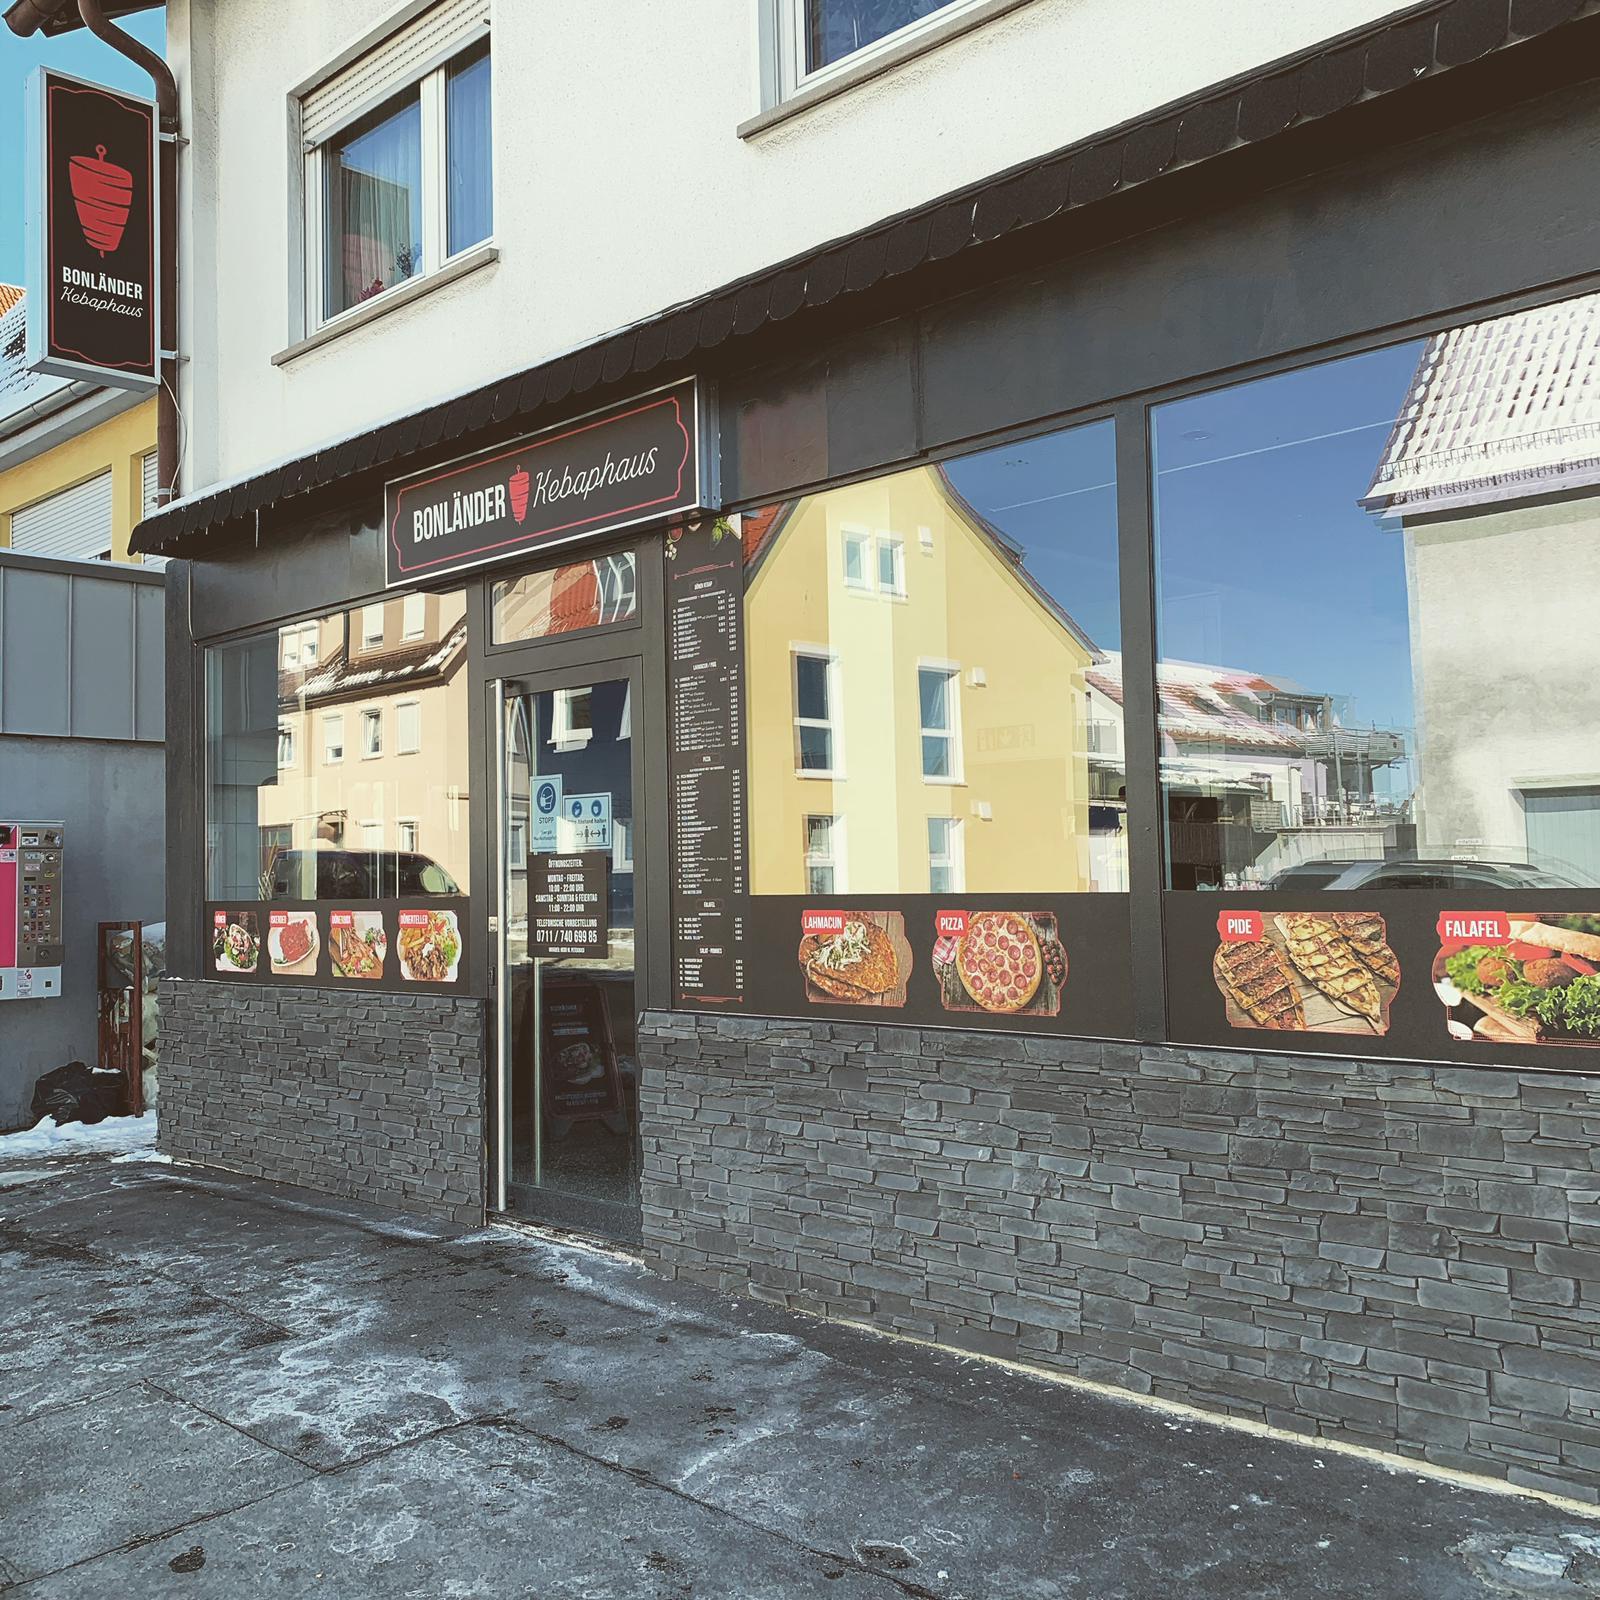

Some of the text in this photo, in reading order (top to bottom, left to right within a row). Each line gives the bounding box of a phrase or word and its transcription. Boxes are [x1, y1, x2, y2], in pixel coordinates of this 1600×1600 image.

[62, 266, 143, 300] BONLÄNDER
[60, 286, 144, 318] Kebaphaus
[413, 446, 658, 544] BONLÄNDER Kebaphaus
[538, 816, 554, 824] STOPP
[548, 874, 564, 882] MONTAG
[804, 916, 843, 930] LAHMACUN
[940, 916, 964, 931] PIZZA
[1228, 918, 1253, 935] PIDE
[1444, 919, 1502, 938] FALAFEL
[536, 930, 553, 942] 0711
[560, 930, 572, 942] 740
[574, 930, 587, 942] 699
[588, 930, 598, 942] 85
